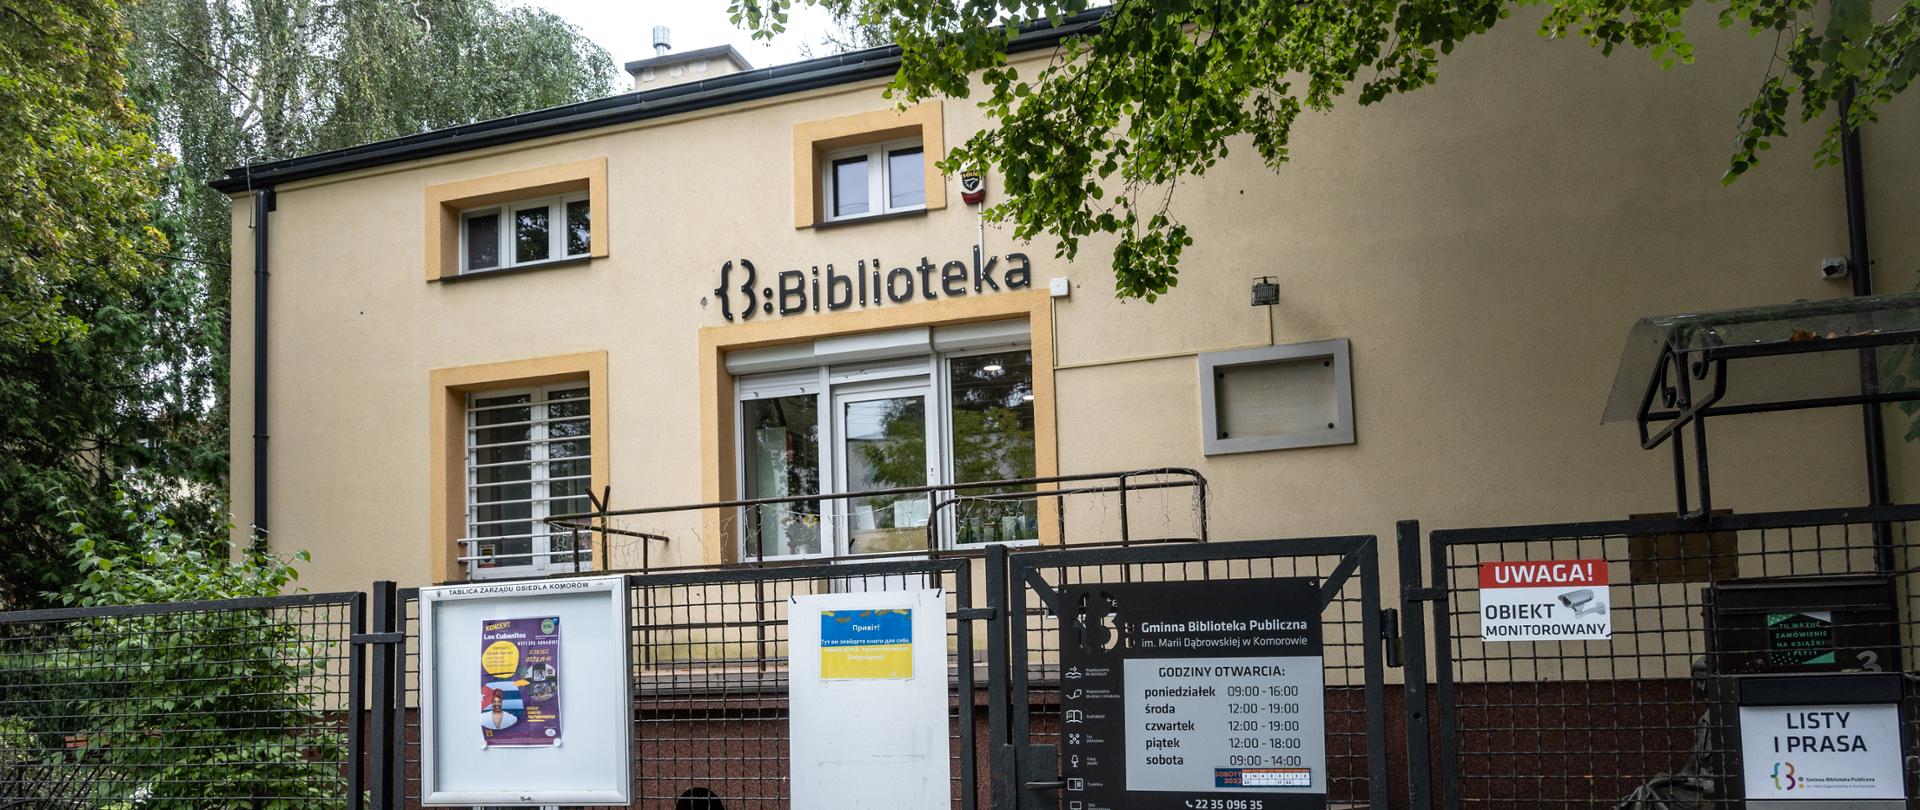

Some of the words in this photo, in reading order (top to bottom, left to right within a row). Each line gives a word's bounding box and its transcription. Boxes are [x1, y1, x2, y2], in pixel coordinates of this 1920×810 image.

[778, 244, 1032, 316] Biblioteka
[1495, 562, 1594, 584] UWAGA!
[449, 587, 478, 595] TABLICA
[480, 586, 514, 594] ZARZĄDU
[550, 582, 589, 590] KOMORÓW
[1485, 604, 1555, 620] OBIEKT
[486, 622, 511, 631] KONCERT
[852, 624, 880, 632] Привіт!
[1141, 621, 1185, 633] Gminna
[1188, 620, 1246, 632] Biblioteka
[1250, 618, 1308, 631] Publiczna
[1485, 623, 1606, 636] MONITOROWANY
[1142, 638, 1156, 648] im.
[1159, 638, 1182, 647] Marii
[1184, 637, 1241, 649] Dąbrowskiej
[1253, 636, 1308, 646] Komorowie
[1158, 667, 1211, 678] GODZINY
[1215, 666, 1285, 677] OTWARCIA:
[1144, 686, 1216, 699] poniedziałek
[1227, 686, 1260, 697] 09:00
[1269, 686, 1298, 697] 16:00
[1145, 703, 1176, 715] środa
[1228, 703, 1258, 714] 12:00
[1268, 703, 1299, 714] 19:00
[1145, 720, 1195, 731] czwartek
[1228, 721, 1258, 731] 12:00
[1269, 720, 1300, 731] 19:00
[1787, 712, 1850, 730] LISTY
[1146, 737, 1180, 750] piątek
[1229, 738, 1259, 749] 12:00
[1270, 738, 1301, 748] 18:00
[1774, 737, 1780, 753] I
[1786, 735, 1868, 753] PRASA
[1146, 755, 1184, 766] sobota
[1229, 755, 1262, 766] 09:00
[1271, 755, 1301, 766] 14:00
[1195, 799, 1208, 809] 22
[1211, 800, 1223, 809] 35
[1227, 800, 1247, 809] 096
[1250, 800, 1262, 810] 35
